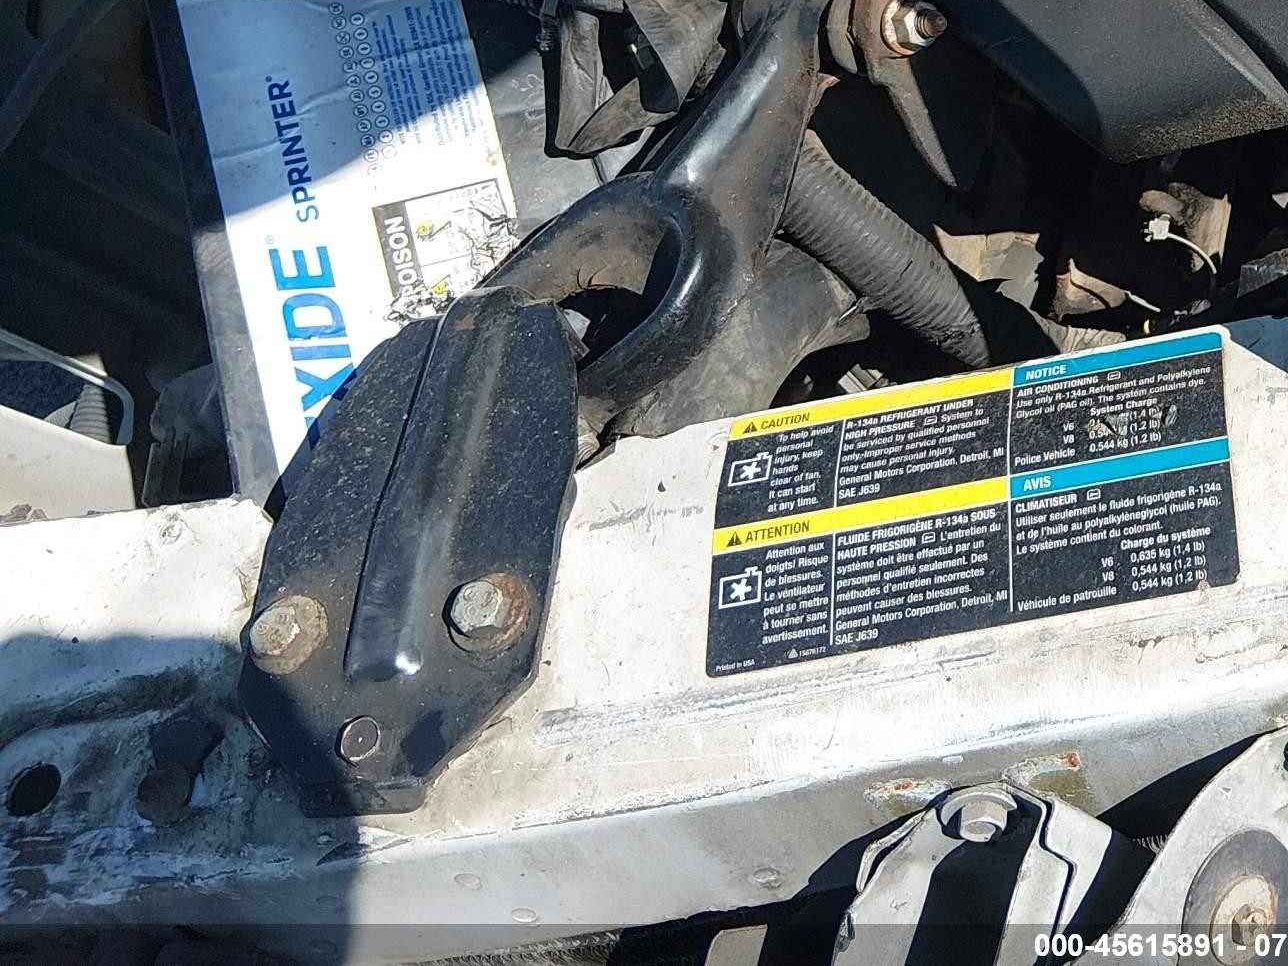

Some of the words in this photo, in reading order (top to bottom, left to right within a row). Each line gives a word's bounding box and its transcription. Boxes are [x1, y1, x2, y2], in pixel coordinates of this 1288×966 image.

[1025, 364, 1067, 380] NOTICE
[1016, 387, 1033, 397] AIR
[1035, 375, 1099, 394] CONDITIONING
[846, 416, 878, 429] R-134a
[879, 404, 941, 423] REFRIGERANT
[942, 398, 974, 412] UNDER
[1090, 403, 1123, 416] System
[1125, 397, 1158, 409] Charge
[760, 412, 810, 430] CAUTION
[844, 428, 867, 440] HIGH
[868, 419, 916, 435] PRESSURE
[940, 411, 973, 424] System
[974, 408, 984, 417] to
[1062, 422, 1074, 431] V6
[1062, 434, 1075, 444] V8
[1129, 421, 1147, 434] (1.2
[1014, 454, 1041, 466] Police
[1043, 447, 1075, 460] Vehicle
[1089, 439, 1115, 452] 0.544
[1116, 438, 1129, 448] kg
[1130, 433, 1147, 447] (1.2
[1149, 431, 1162, 442] lb)
[838, 471, 872, 486] General
[873, 467, 904, 480] Motors
[905, 458, 958, 474] Corporation,
[959, 450, 991, 464] Detroit,
[993, 447, 1004, 458] MI
[768, 490, 775, 499] It
[776, 488, 793, 497] can
[794, 482, 816, 494] start
[838, 487, 856, 499] SAE
[857, 483, 880, 495] J639
[1023, 475, 1051, 491] AVIS
[766, 502, 778, 512] at
[779, 501, 794, 511] any
[796, 497, 819, 507] time.
[1015, 493, 1077, 513] CLIMATISEUR
[1015, 514, 1046, 527] Utiliser
[1048, 503, 1096, 521] seulement
[1098, 502, 1107, 512] le
[1108, 497, 1135, 510] fluide
[1136, 489, 1186, 506] frigorigène
[1187, 482, 1222, 496] R-134a
[837, 531, 870, 546] FLUIDE
[871, 520, 933, 540] FRIGORIGÈNE
[934, 515, 969, 528] R-134a
[970, 509, 996, 522] SOUS
[1015, 530, 1025, 541] et
[1027, 528, 1039, 539] de
[1041, 523, 1069, 536] l'huile
[1070, 522, 1082, 531] au
[1084, 504, 1167, 530] polyalkylèneglycol
[1169, 500, 1195, 515] (huile
[1196, 495, 1221, 508] PAG).
[744, 520, 810, 543] ATTENTION
[837, 545, 868, 560] HAUTE
[869, 536, 916, 554] PRESSION
[939, 525, 987, 541] L'entretien
[989, 522, 1001, 532] du
[1016, 544, 1027, 554] Le
[1028, 538, 1067, 553] système
[1069, 529, 1107, 545] contient
[1108, 527, 1121, 538] du
[1122, 519, 1163, 535] colorant.
[1120, 537, 1154, 550] Charge
[1155, 533, 1169, 544] du
[1170, 526, 1211, 542] système
[765, 545, 806, 559] Attention
[807, 542, 825, 552] aux
[797, 555, 829, 567] Risque
[835, 560, 874, 575] système
[876, 555, 894, 566] doit
[896, 552, 914, 563] être
[915, 544, 953, 559] effectué
[955, 543, 970, 554] par
[972, 540, 984, 549] un
[1100, 556, 1114, 568] V6
[1129, 549, 1157, 562] 0,635
[1158, 547, 1171, 558] kg
[1172, 542, 1190, 557] (1,4
[1192, 540, 1206, 551] lb)
[764, 577, 777, 587] de
[777, 570, 823, 585] blessures.
[835, 571, 881, 590] personnel
[882, 564, 916, 581] qualifié
[918, 555, 968, 573] seulement.
[971, 553, 988, 563] Des
[1101, 570, 1115, 582] V8
[1130, 562, 1158, 577] 0,544
[1159, 561, 1172, 573] kg
[1173, 556, 1191, 571] (1,2
[1193, 554, 1207, 566] lb)
[763, 591, 776, 601] Le
[776, 583, 825, 599] ventilateur
[836, 587, 881, 602] méthodes
[882, 577, 931, 593] d'entretien
[933, 568, 985, 584] incorrectes
[1017, 596, 1057, 611] Véhicule
[1059, 593, 1071, 604] de
[1072, 585, 1117, 604] patrouille
[1131, 576, 1159, 591] 0,544
[1160, 575, 1173, 587] kg
[1174, 570, 1193, 585] (1,2
[1194, 567, 1208, 580] lb)
[762, 602, 784, 617] peut
[785, 602, 797, 611] se
[798, 596, 829, 609] mettre
[834, 615, 869, 630] General
[871, 611, 903, 624] Motors
[904, 601, 959, 618] Corporation,
[961, 593, 994, 607] Detroit,
[996, 590, 1007, 601] MI
[835, 600, 872, 618] peuvent
[874, 596, 905, 609] causer
[907, 593, 924, 603] des
[925, 585, 972, 600] blessures.
[761, 620, 769, 630] à
[770, 615, 804, 629] tourner
[805, 611, 828, 622] sans
[761, 624, 828, 644] avertissement.
[834, 632, 854, 645] SAE
[854, 628, 879, 641] J639
